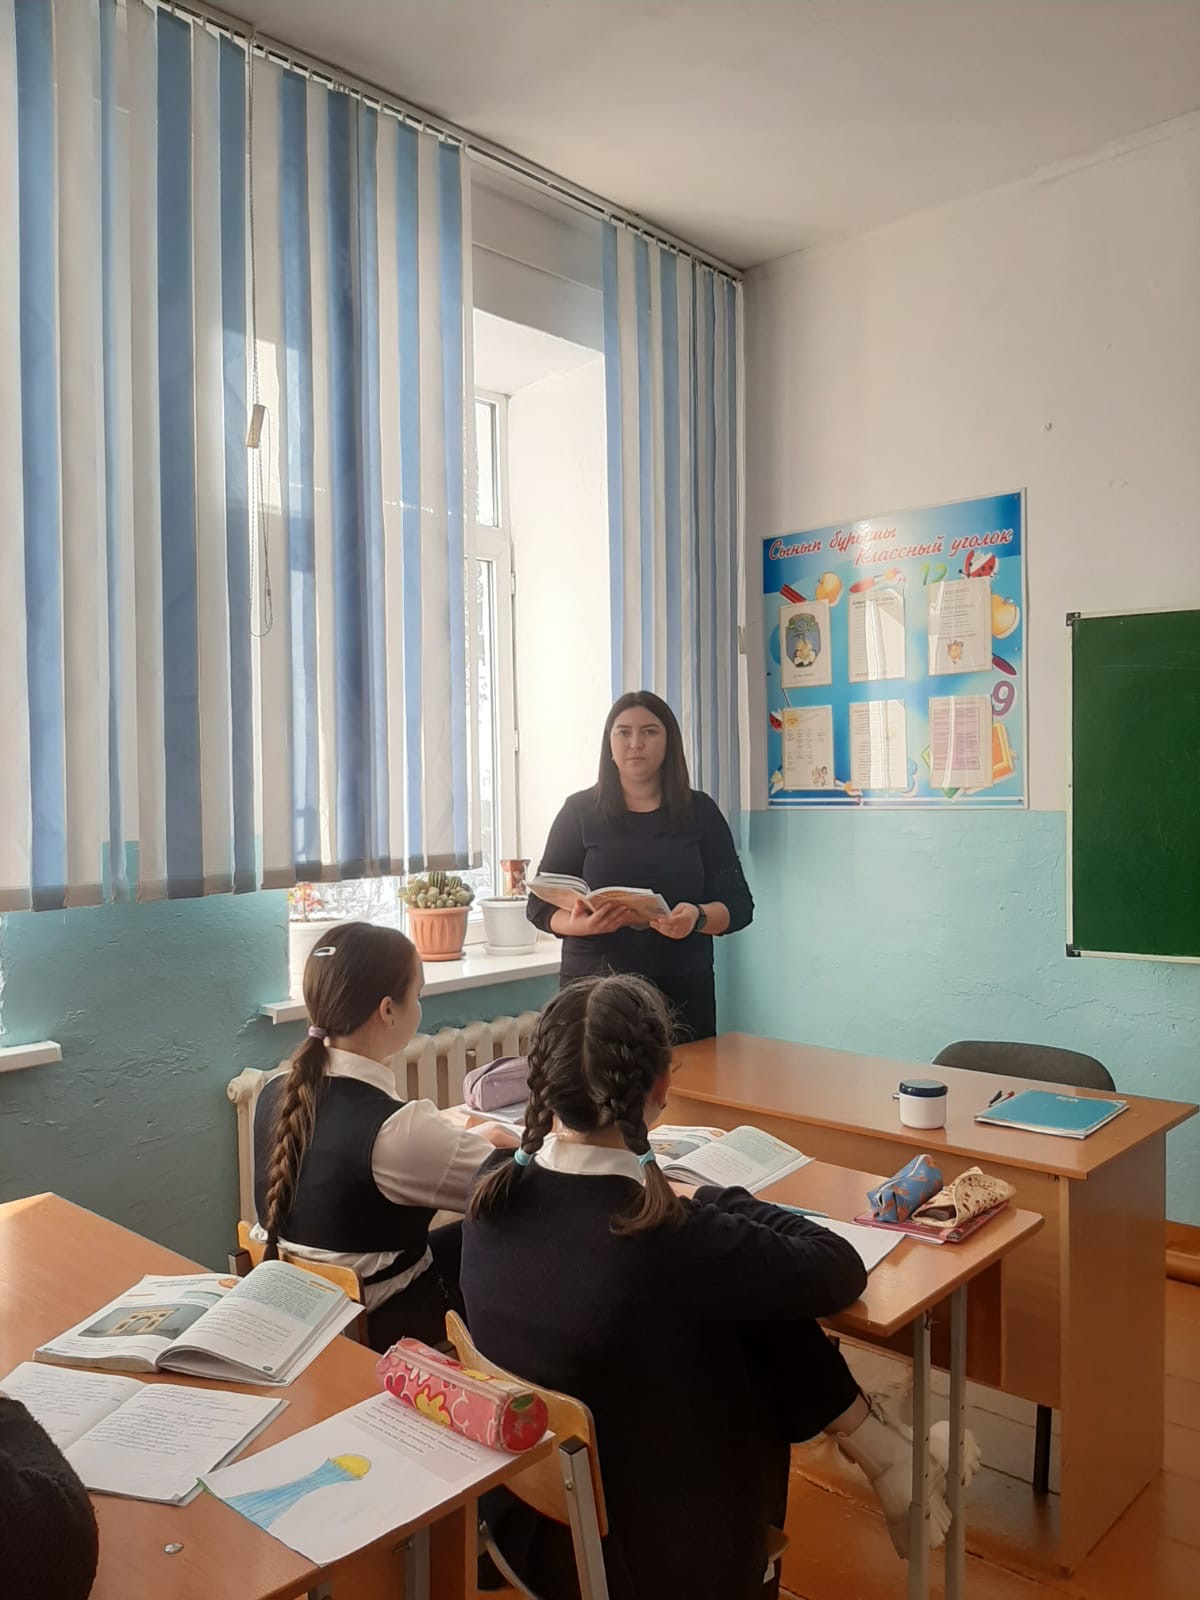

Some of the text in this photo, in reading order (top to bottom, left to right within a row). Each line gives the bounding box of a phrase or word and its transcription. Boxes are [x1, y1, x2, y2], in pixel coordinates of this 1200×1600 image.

[769, 539, 822, 560] Сынып
[947, 529, 1014, 558] уголок
[992, 680, 1016, 717] 9
